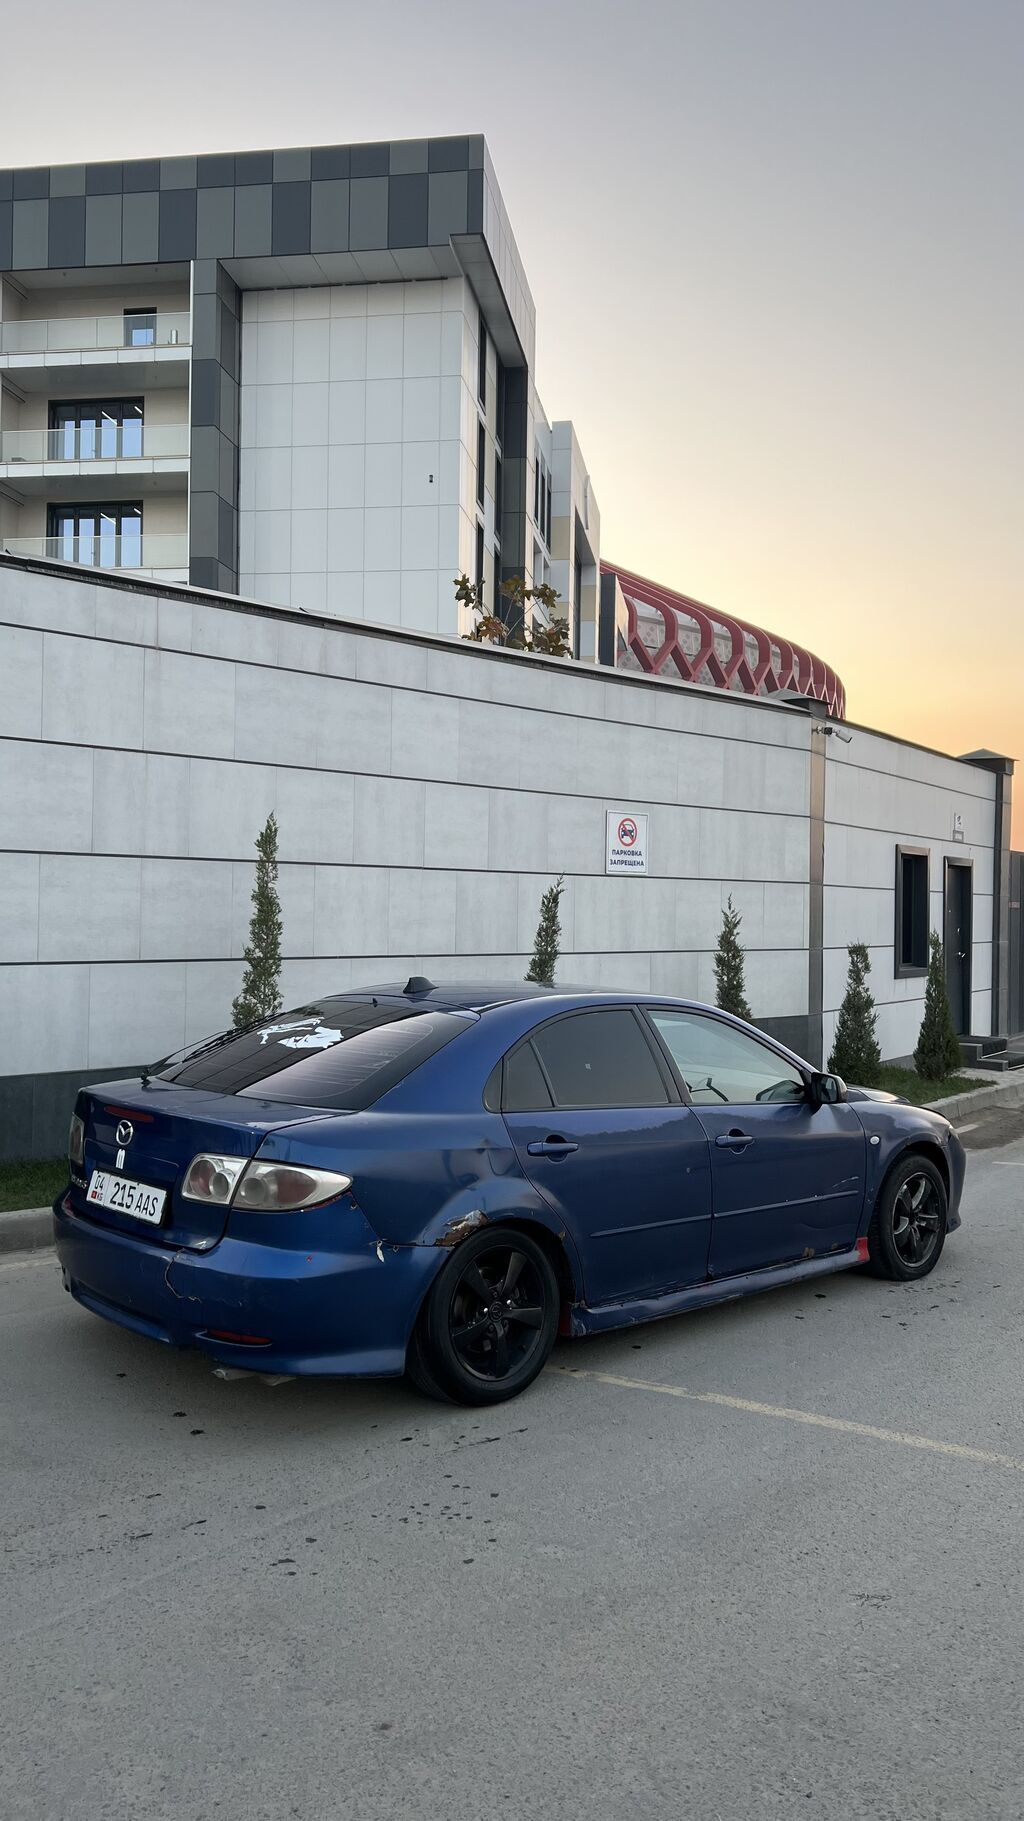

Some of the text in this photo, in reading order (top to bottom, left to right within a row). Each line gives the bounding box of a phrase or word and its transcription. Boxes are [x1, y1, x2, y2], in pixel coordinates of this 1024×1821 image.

[611, 849, 643, 857] ПАРКОВКА
[609, 858, 645, 867] ЗАПРЕЩЕНА
[94, 1174, 106, 1191] 04
[109, 1181, 137, 1210] 215
[134, 1192, 159, 1217] AAS
